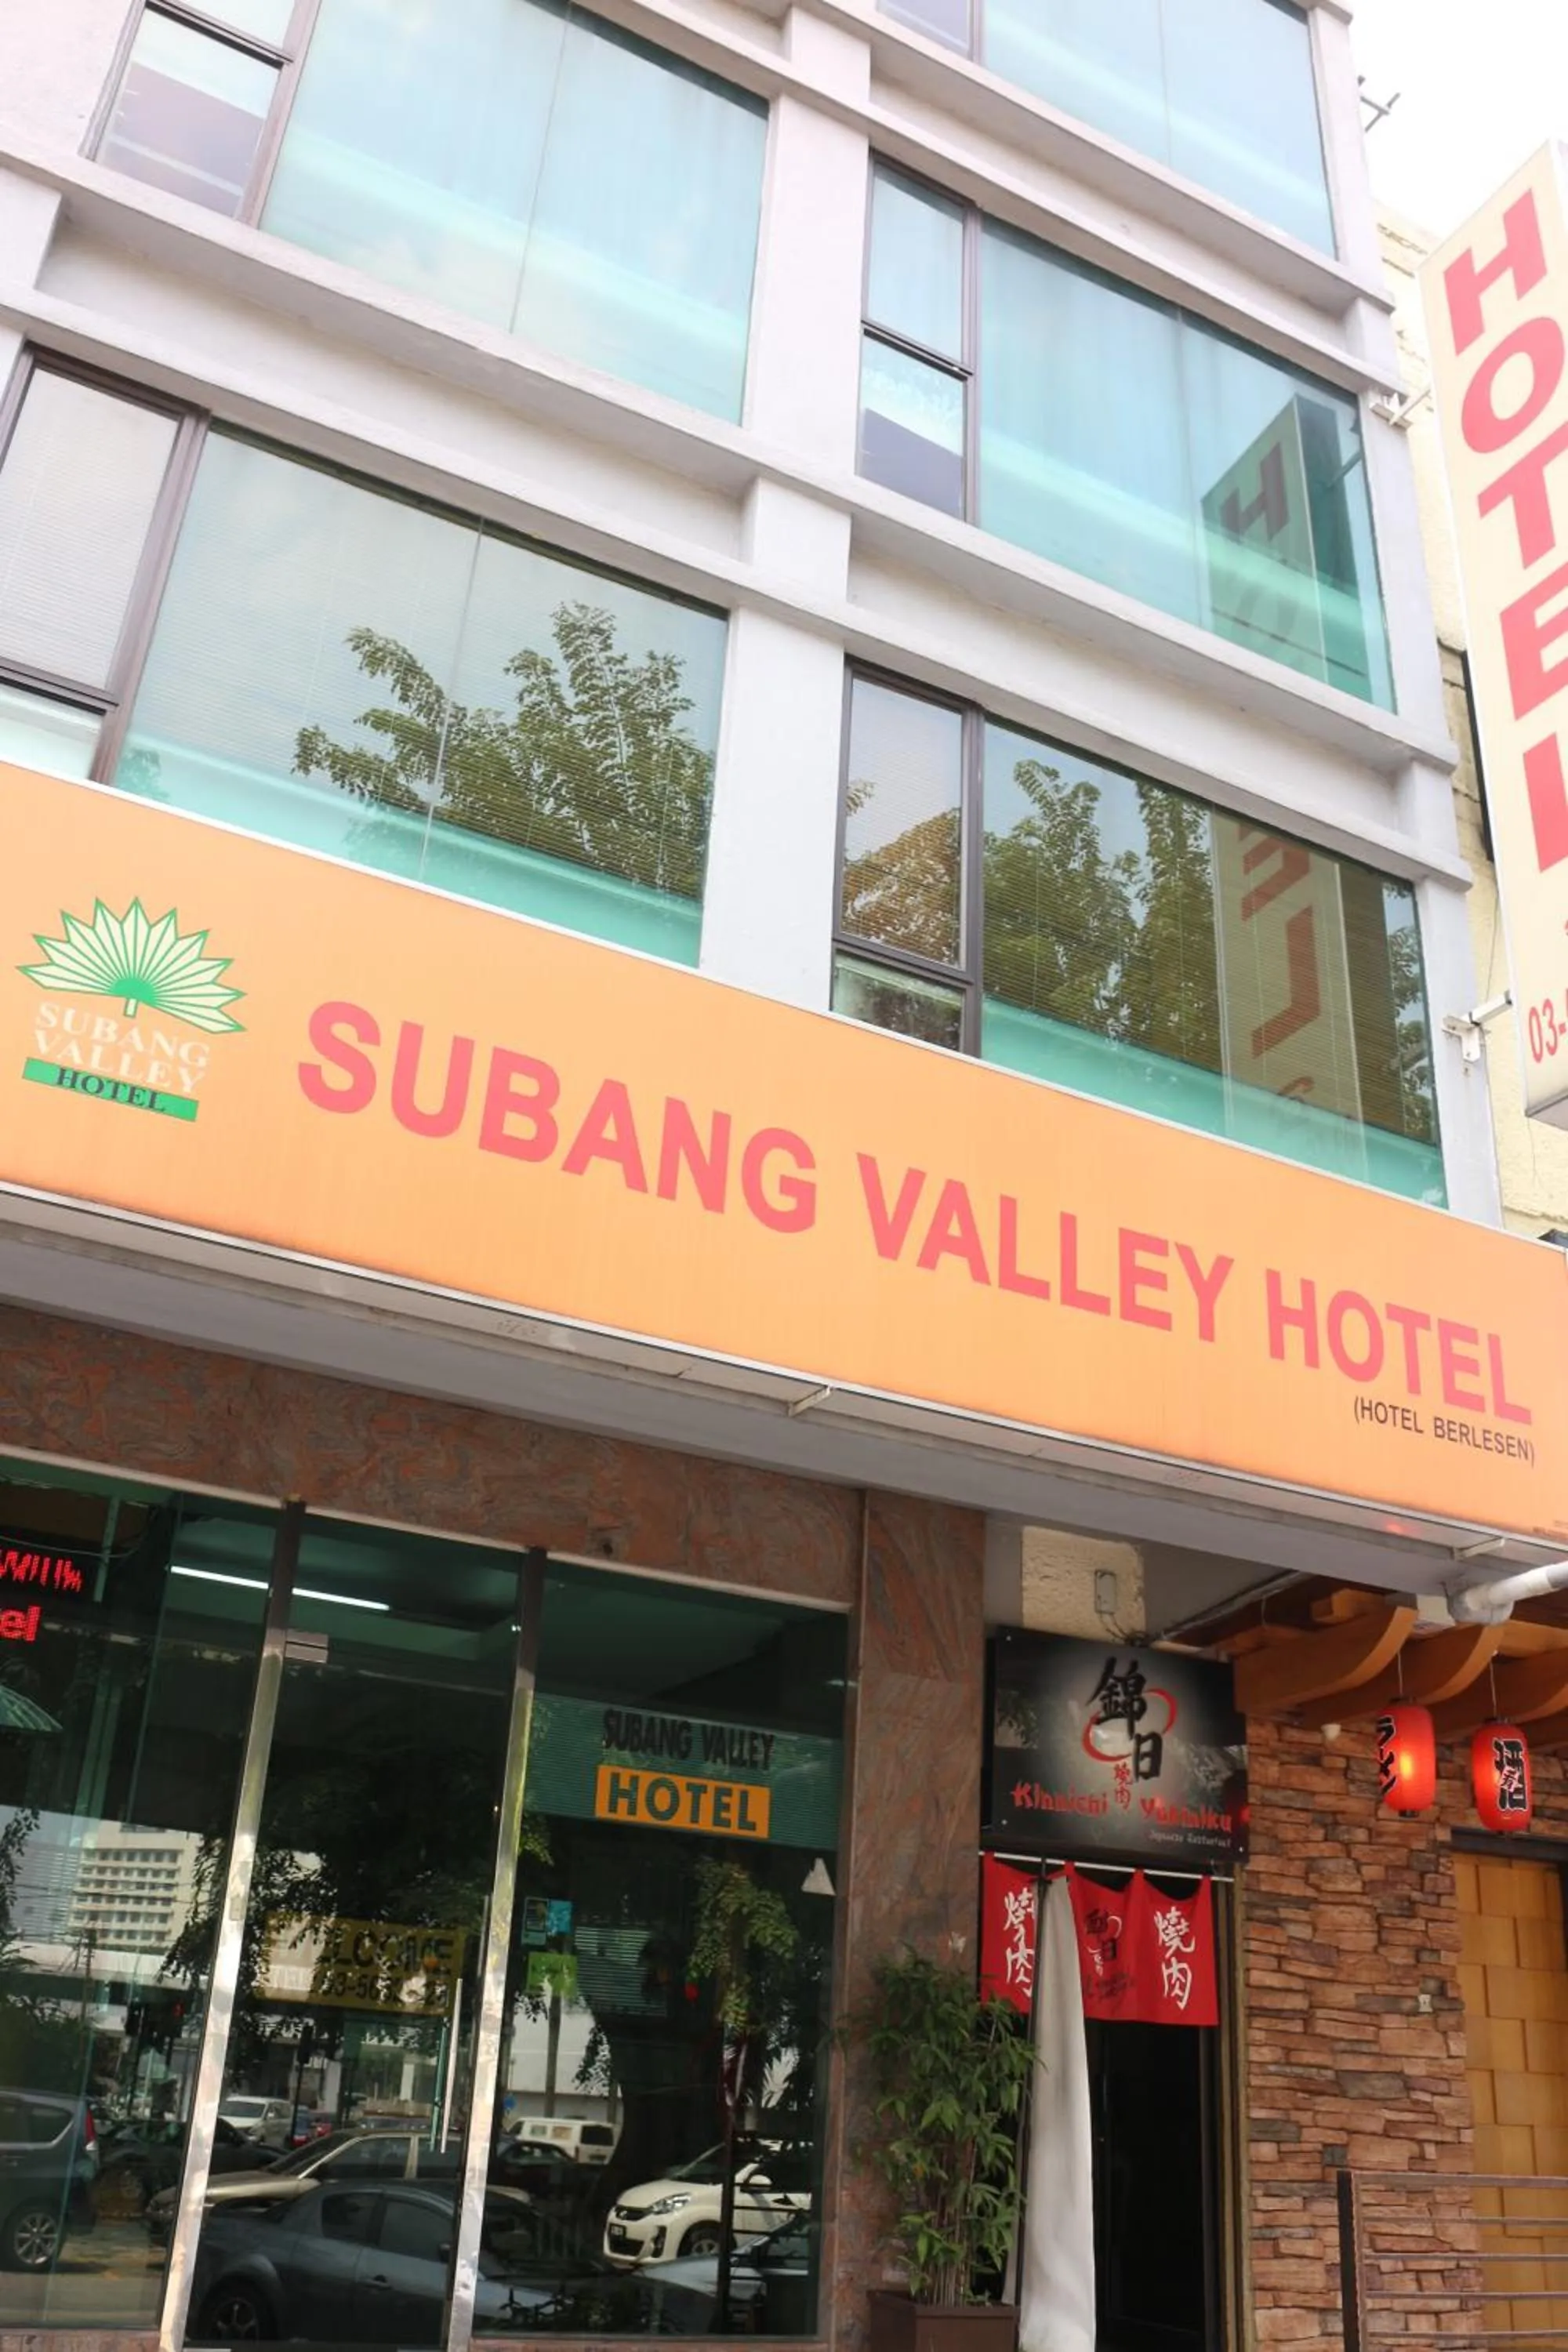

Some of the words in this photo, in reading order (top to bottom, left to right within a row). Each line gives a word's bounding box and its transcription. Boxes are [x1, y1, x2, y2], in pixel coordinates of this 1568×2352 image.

[34, 1002, 210, 1068] SUBANG
[1529, 989, 1568, 1063] 03-
[34, 1029, 205, 1094] VALLEY
[56, 1067, 165, 1112] HOTEL
[299, 1002, 815, 1232] SUBANG
[858, 1153, 1234, 1342] VALLEY
[1266, 1269, 1530, 1424] HOTEL
[1354, 1395, 1425, 1434] (HOTEL
[1433, 1417, 1535, 1468] BERLESEN)
[604, 1709, 692, 1760] SUBANG
[702, 1725, 775, 1770] VALLEY
[608, 1772, 757, 1831] HOTEL
